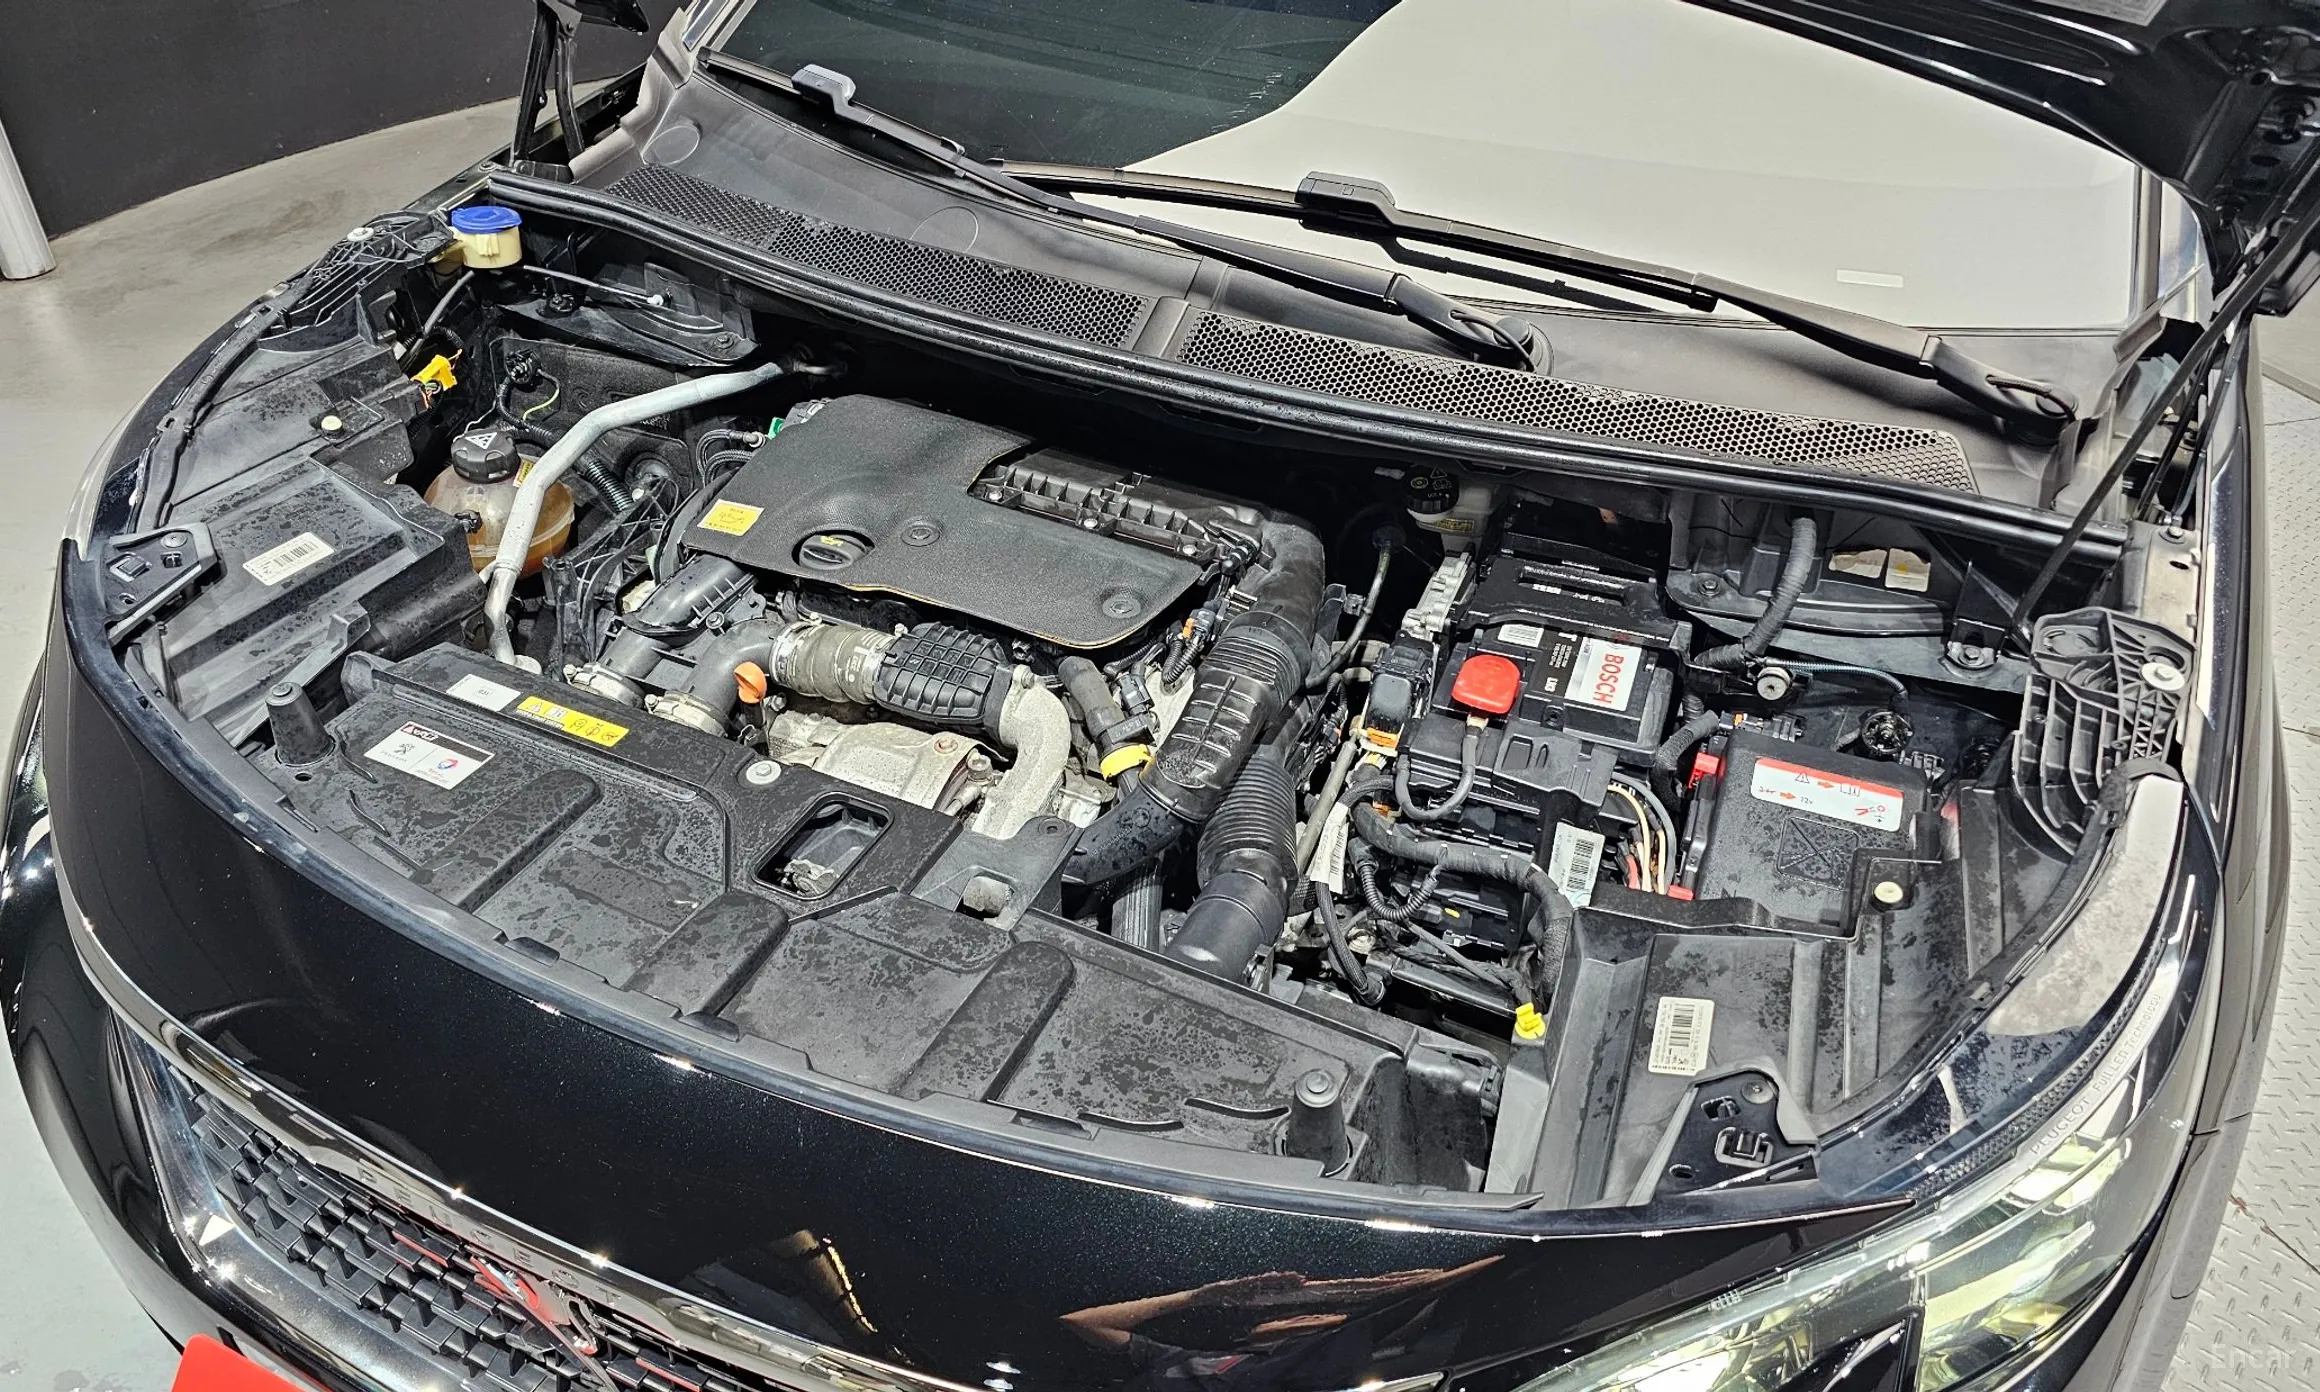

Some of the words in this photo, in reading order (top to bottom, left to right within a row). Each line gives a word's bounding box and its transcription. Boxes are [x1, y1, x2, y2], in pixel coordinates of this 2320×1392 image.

[1592, 653, 1625, 704] BOSCH
[2030, 1096, 2091, 1155] PEUGEOT
[358, 1166, 622, 1307] PEUGEOT
